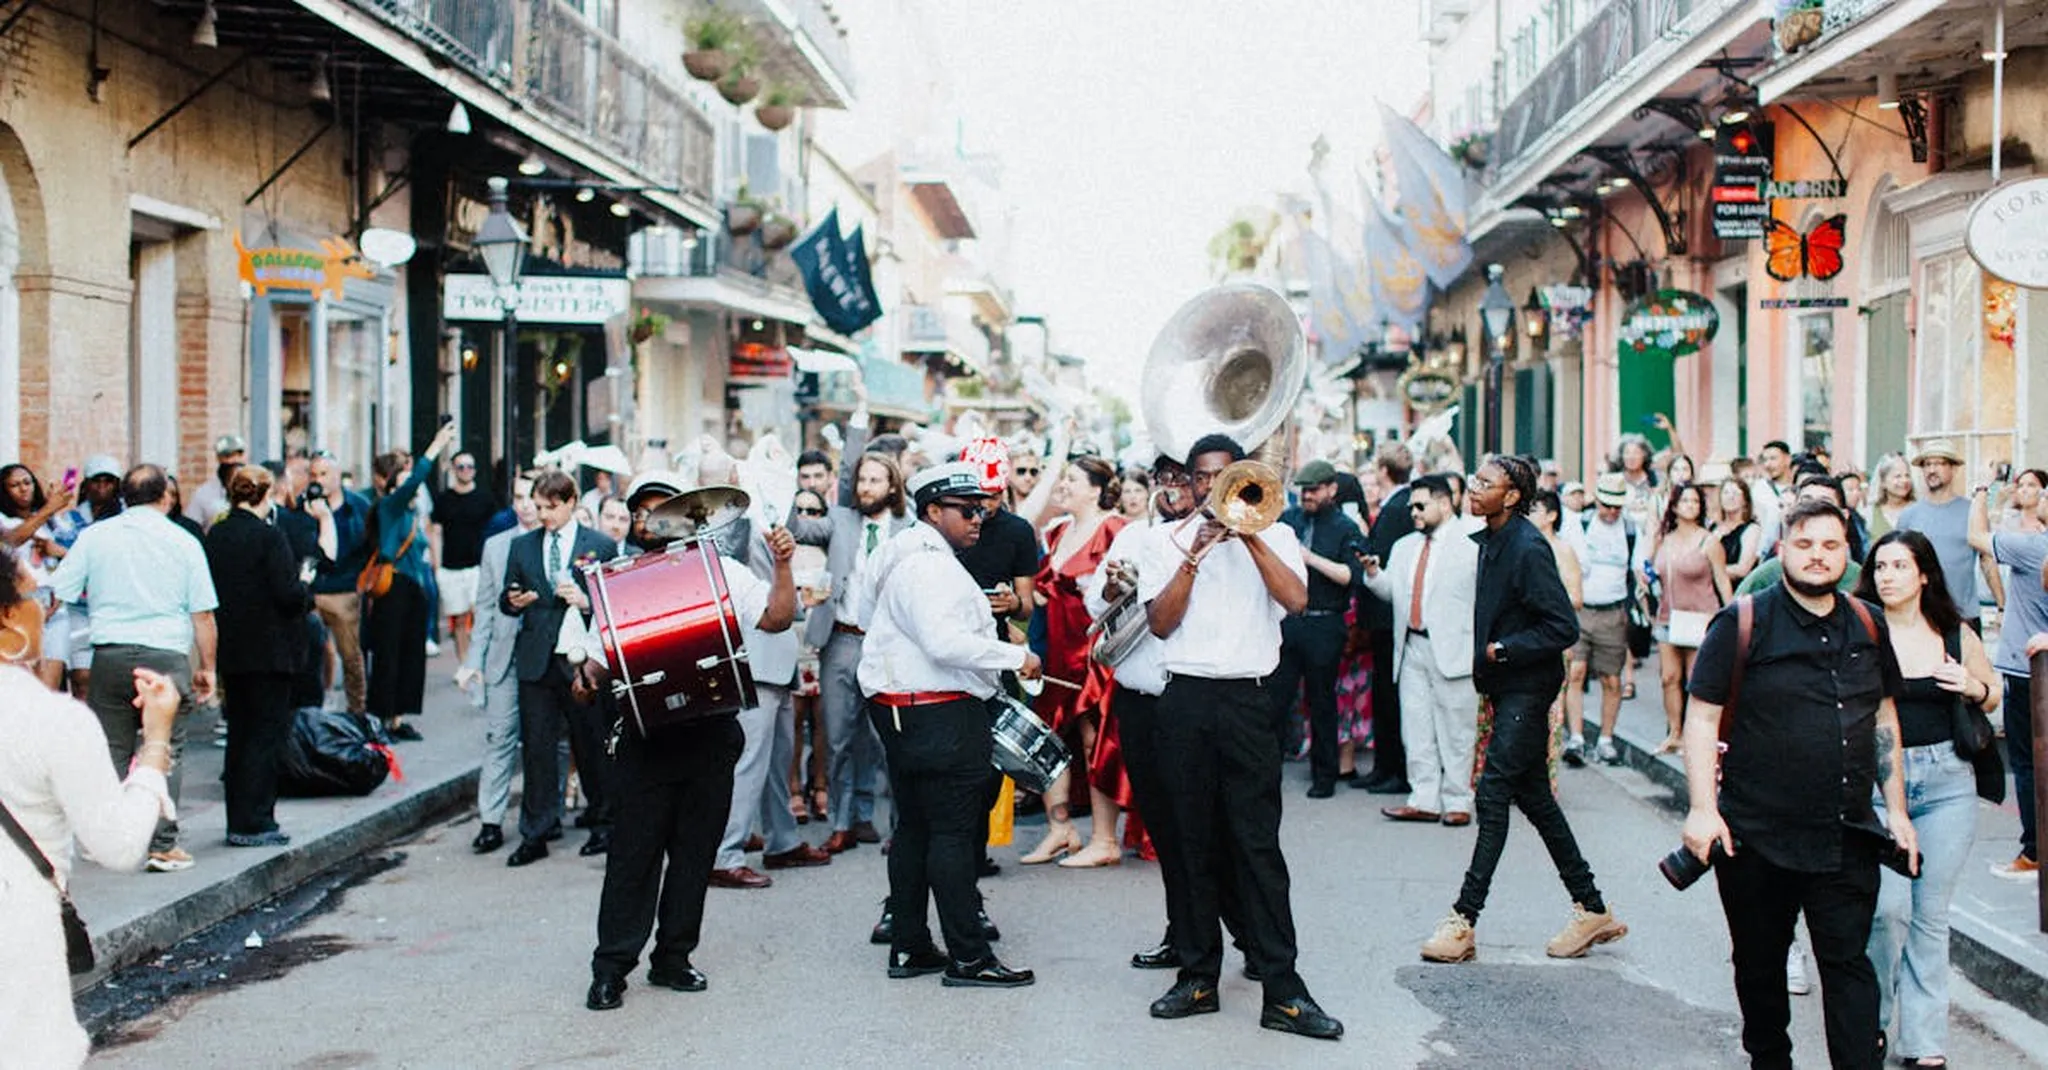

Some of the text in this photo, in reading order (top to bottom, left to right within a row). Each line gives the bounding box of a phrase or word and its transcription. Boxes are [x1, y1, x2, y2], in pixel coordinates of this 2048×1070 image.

[1764, 181, 1839, 199] ADORN
[1716, 203, 1770, 216] FOR LEASE
[1993, 189, 2048, 222] FOR
[455, 295, 506, 310] TWO
